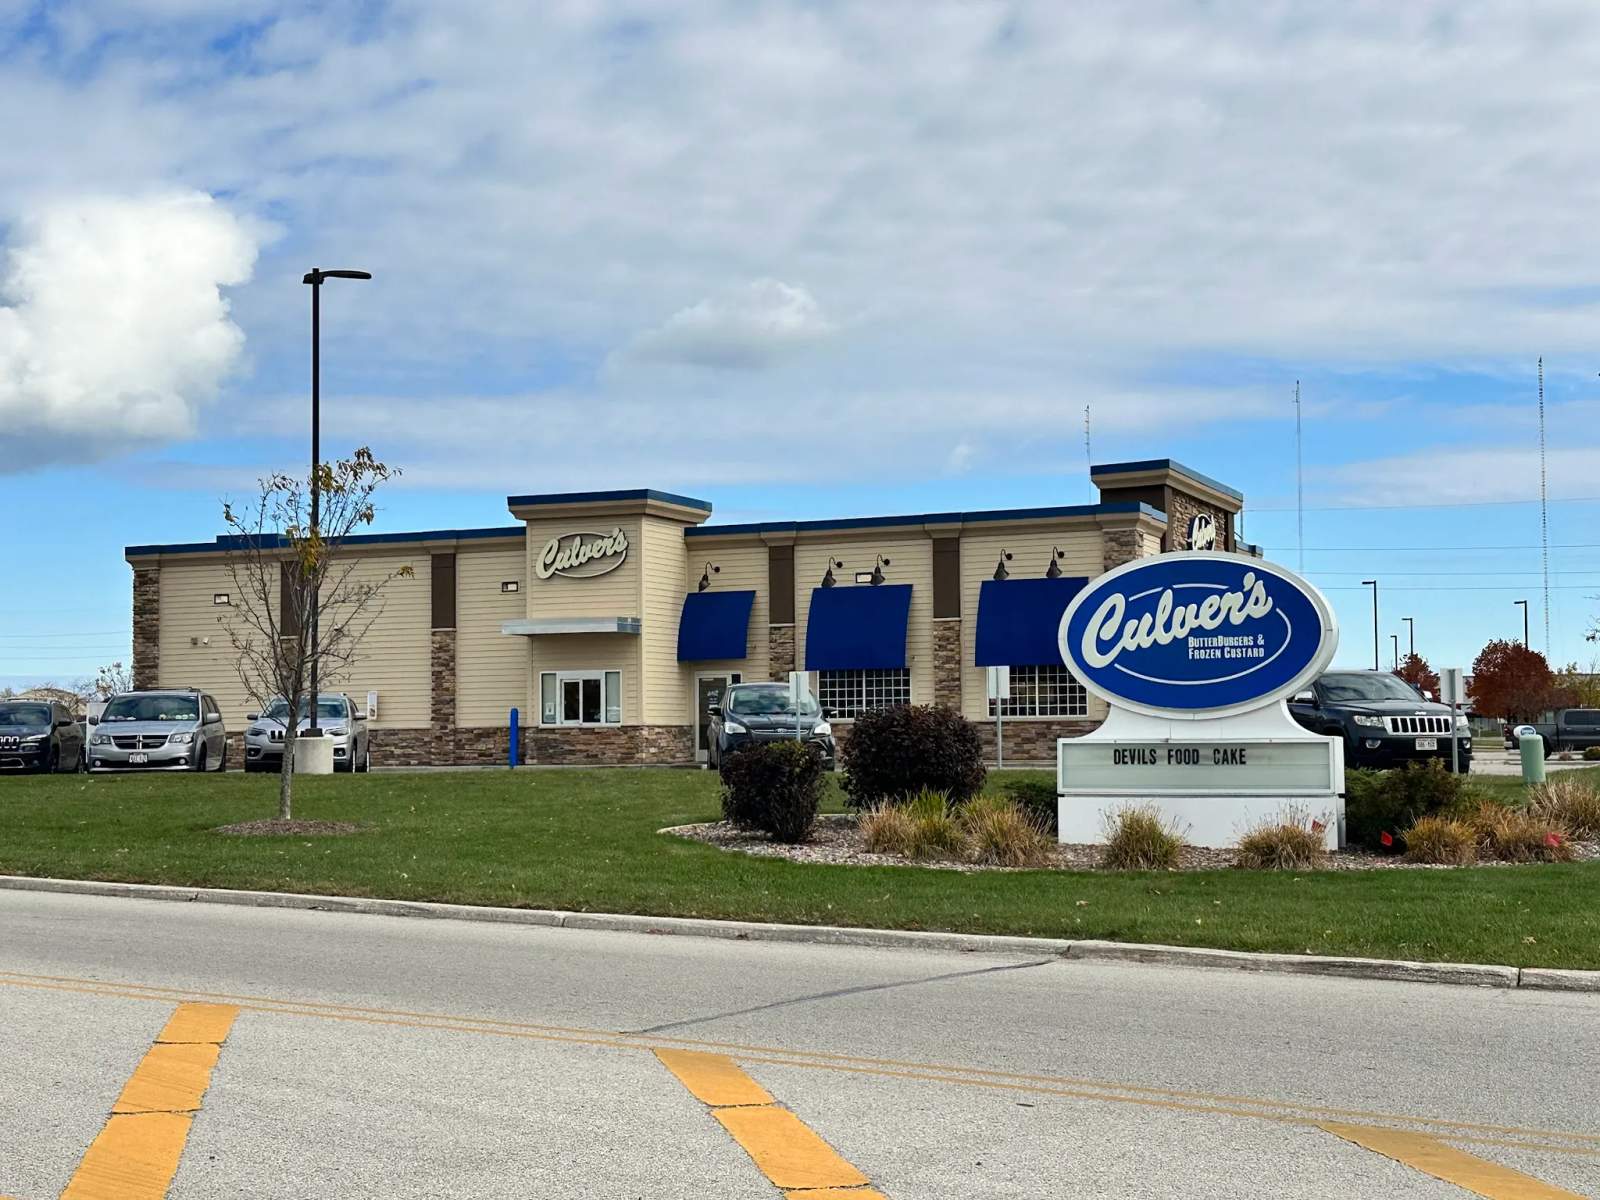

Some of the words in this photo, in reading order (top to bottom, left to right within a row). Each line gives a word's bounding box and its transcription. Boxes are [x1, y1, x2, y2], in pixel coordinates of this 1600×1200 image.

[536, 528, 628, 579] Culver's
[1081, 572, 1273, 668] Culver's
[1257, 634, 1265, 645] &
[1113, 749, 1157, 765] DEVILS
[1167, 749, 1200, 765] FOOD
[1213, 749, 1247, 765] CAKE
